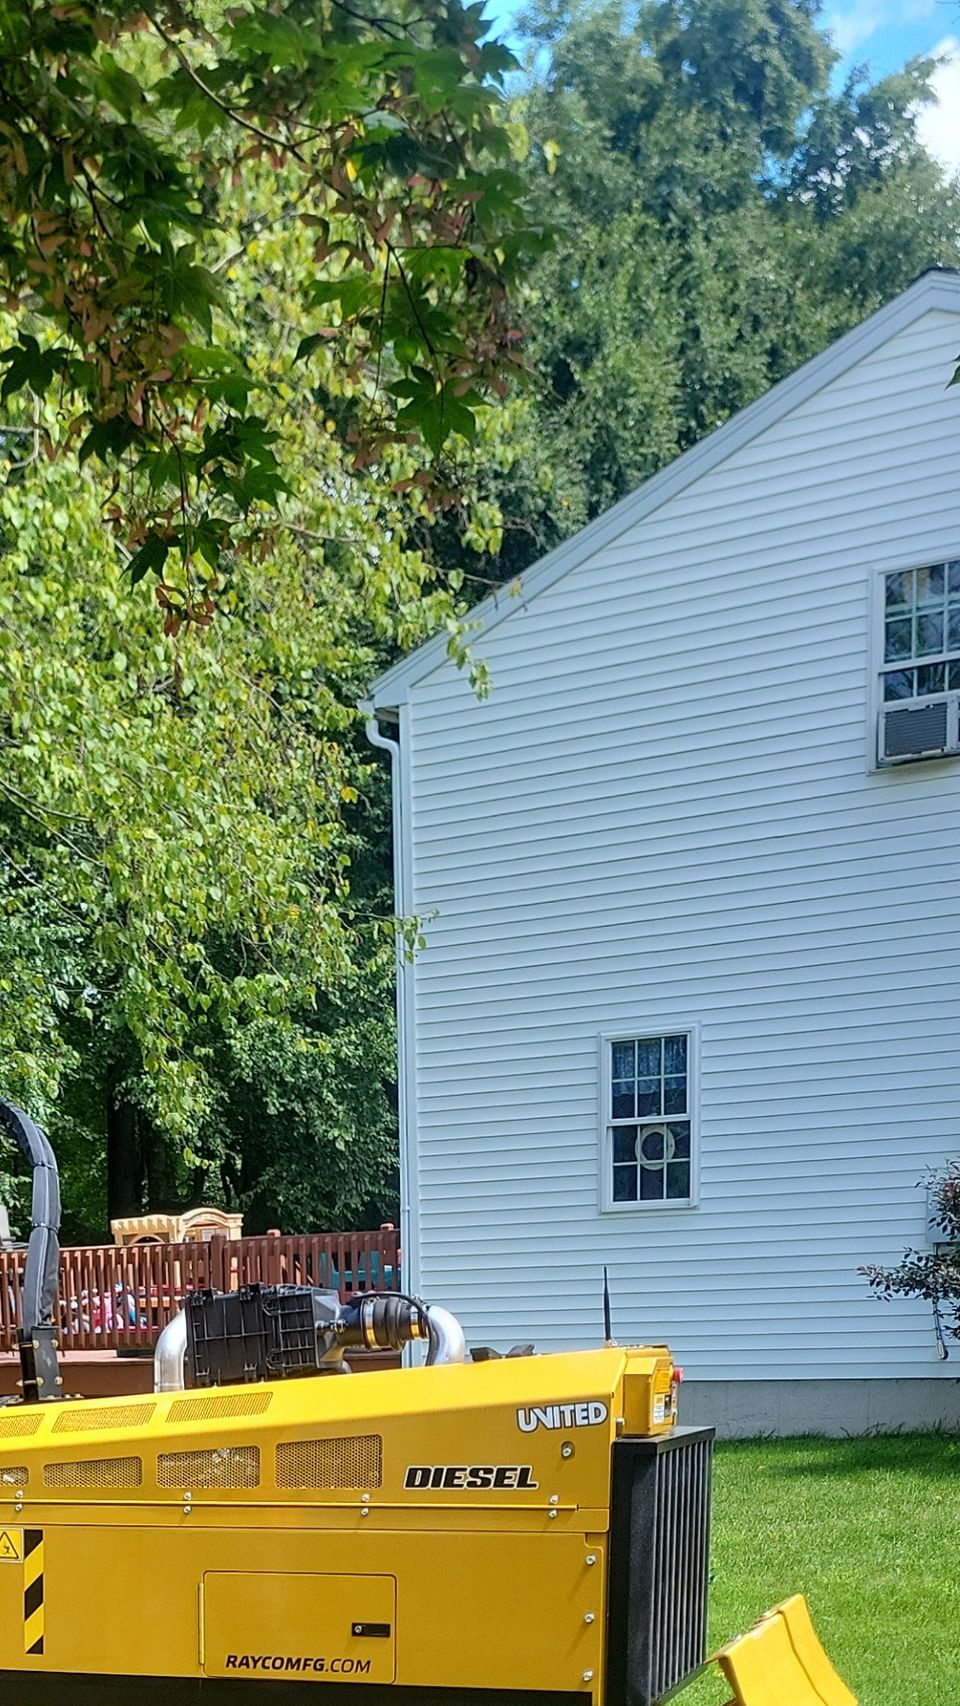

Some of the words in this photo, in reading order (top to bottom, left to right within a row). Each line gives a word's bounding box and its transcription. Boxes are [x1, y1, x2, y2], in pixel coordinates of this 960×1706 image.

[517, 1401, 608, 1433] UNITED
[404, 1466, 539, 1489] DIESEL
[225, 1654, 372, 1674] RAYCOMFG.COM
